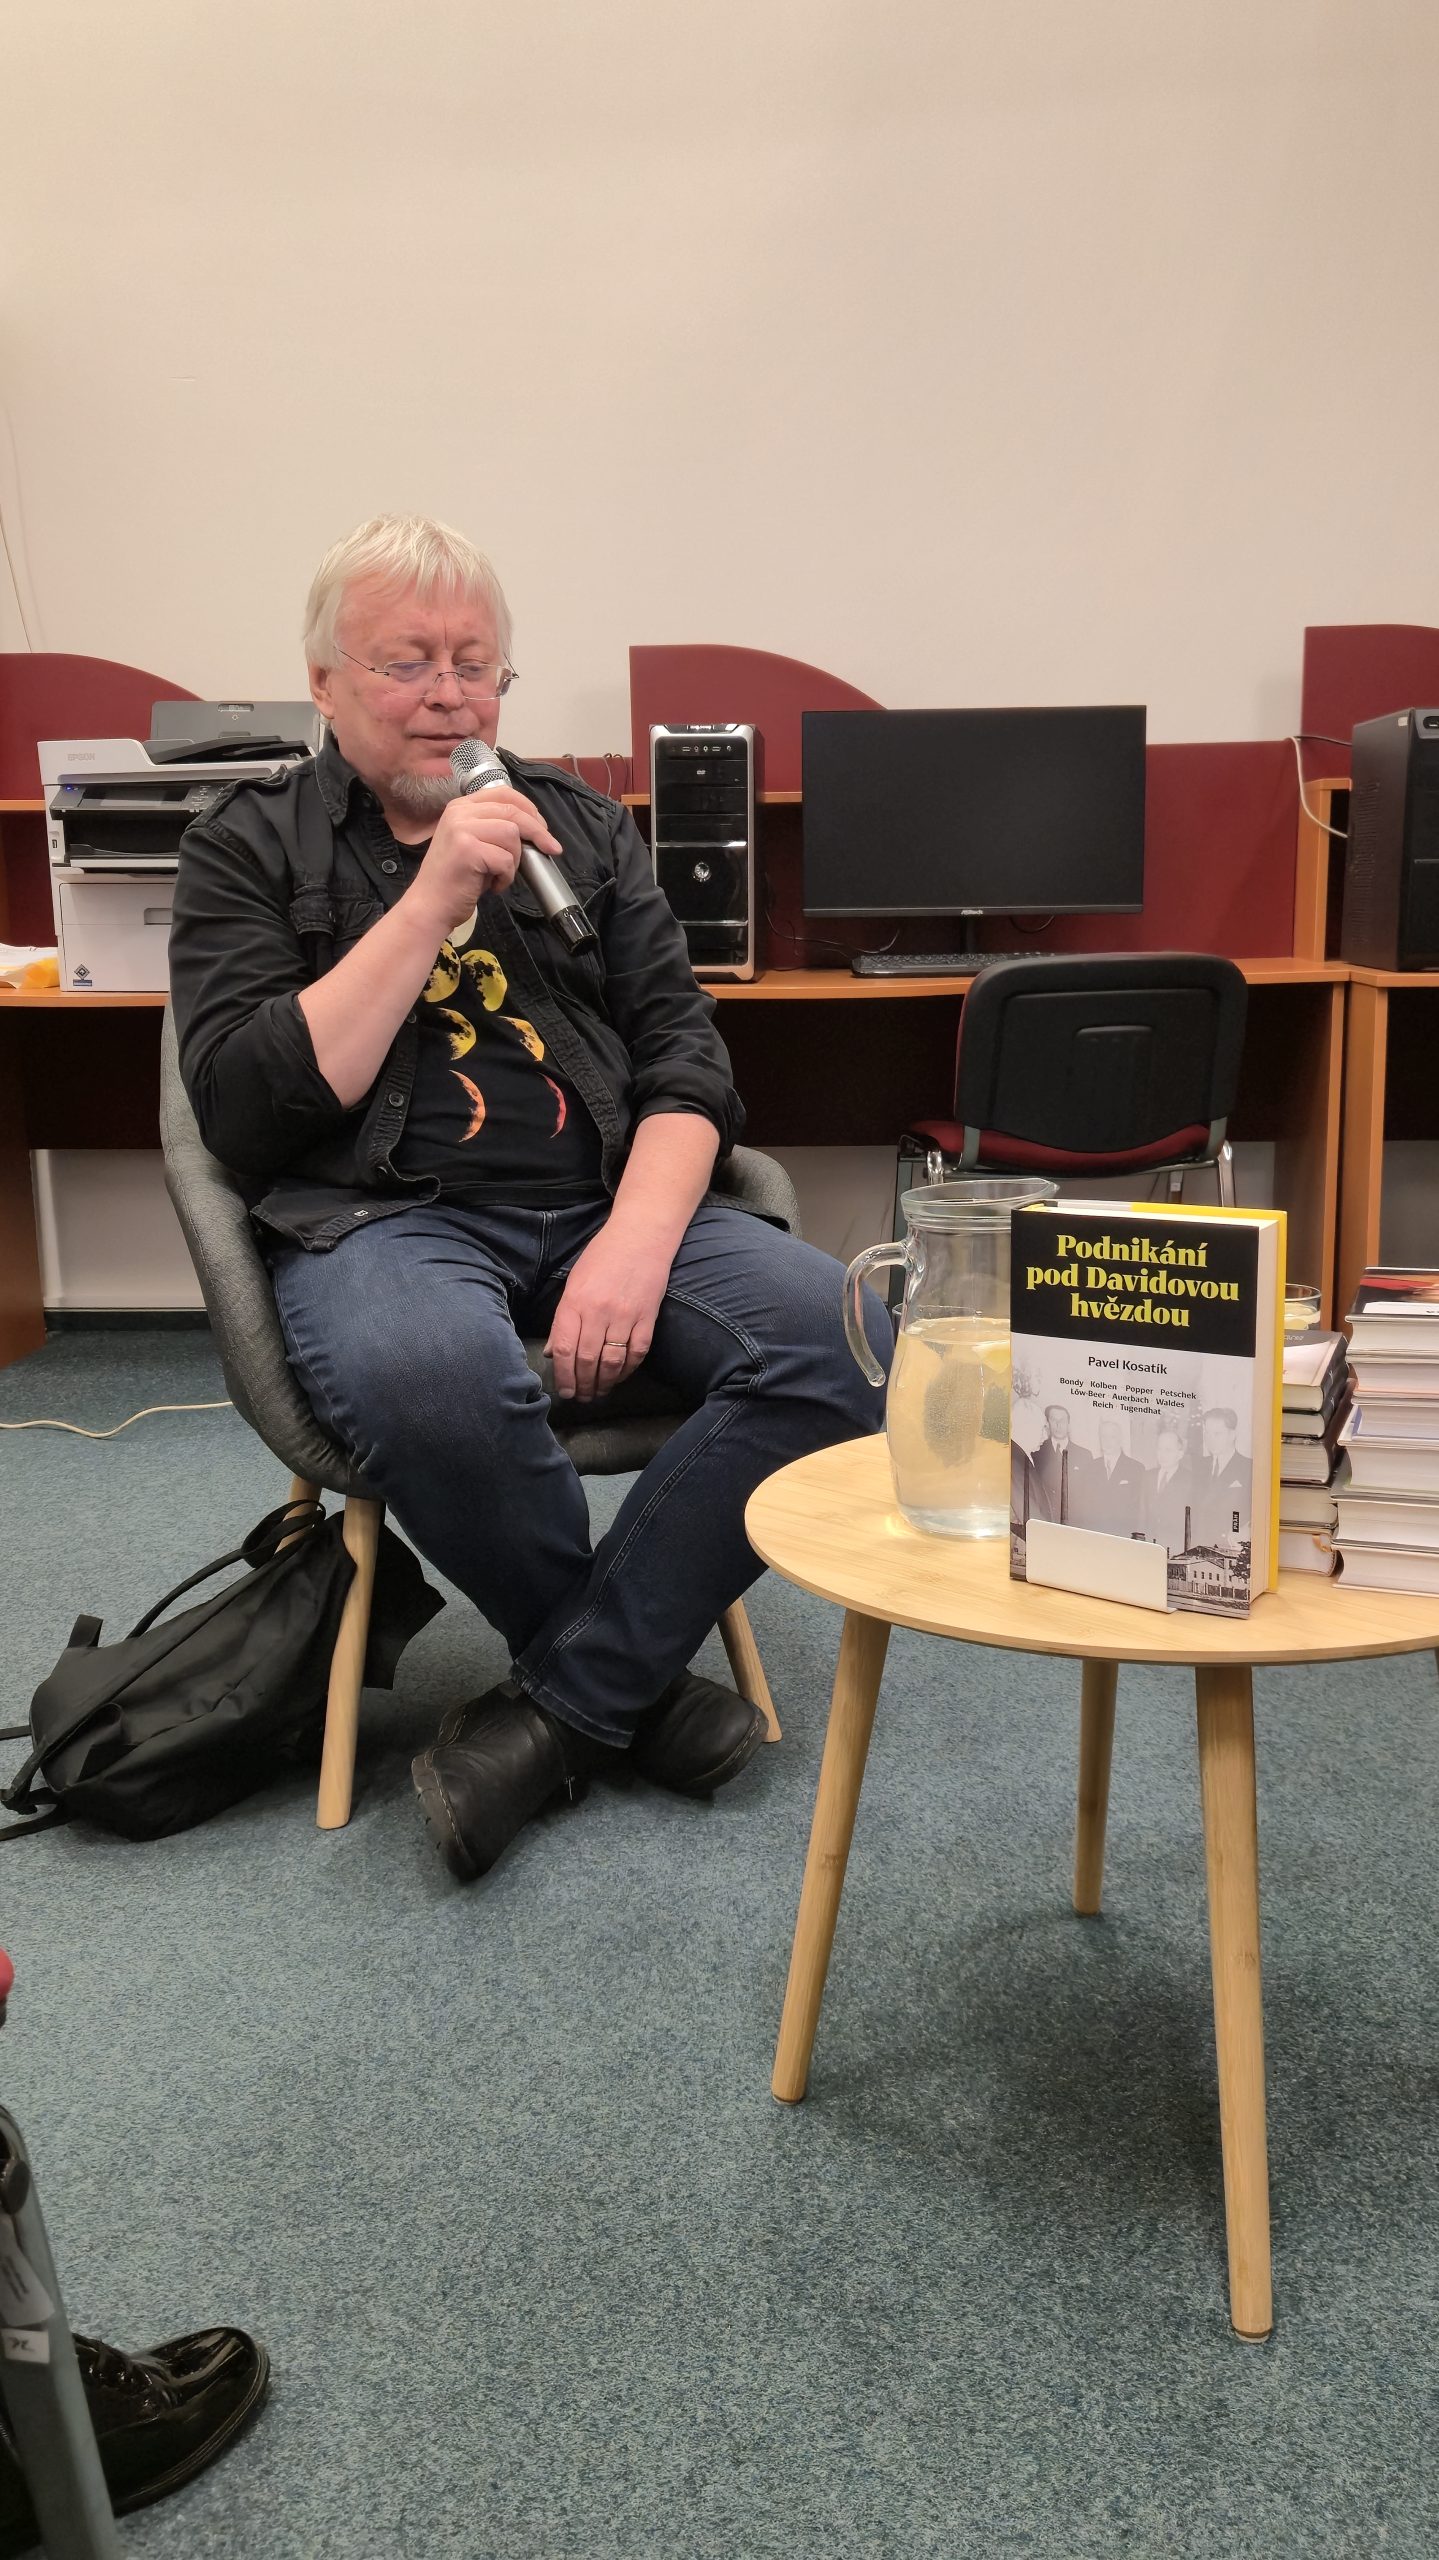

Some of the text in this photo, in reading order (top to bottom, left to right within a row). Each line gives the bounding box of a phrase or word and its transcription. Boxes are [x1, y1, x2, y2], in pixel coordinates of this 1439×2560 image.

[1056, 1234, 1208, 1267] Podnikání
[1026, 1263, 1239, 1301] pod Davidovou
[1070, 1292, 1190, 1327] hvězdou
[1088, 1356, 1168, 1375] Pavel Kosatík
[1059, 1377, 1197, 1400] Bondy Kolben Popper Petschek
[1092, 1400, 1162, 1415] Reich Tugendhat
[1112, 1393, 1149, 1404] Auerbach
[1156, 1398, 1185, 1408] Waldes
